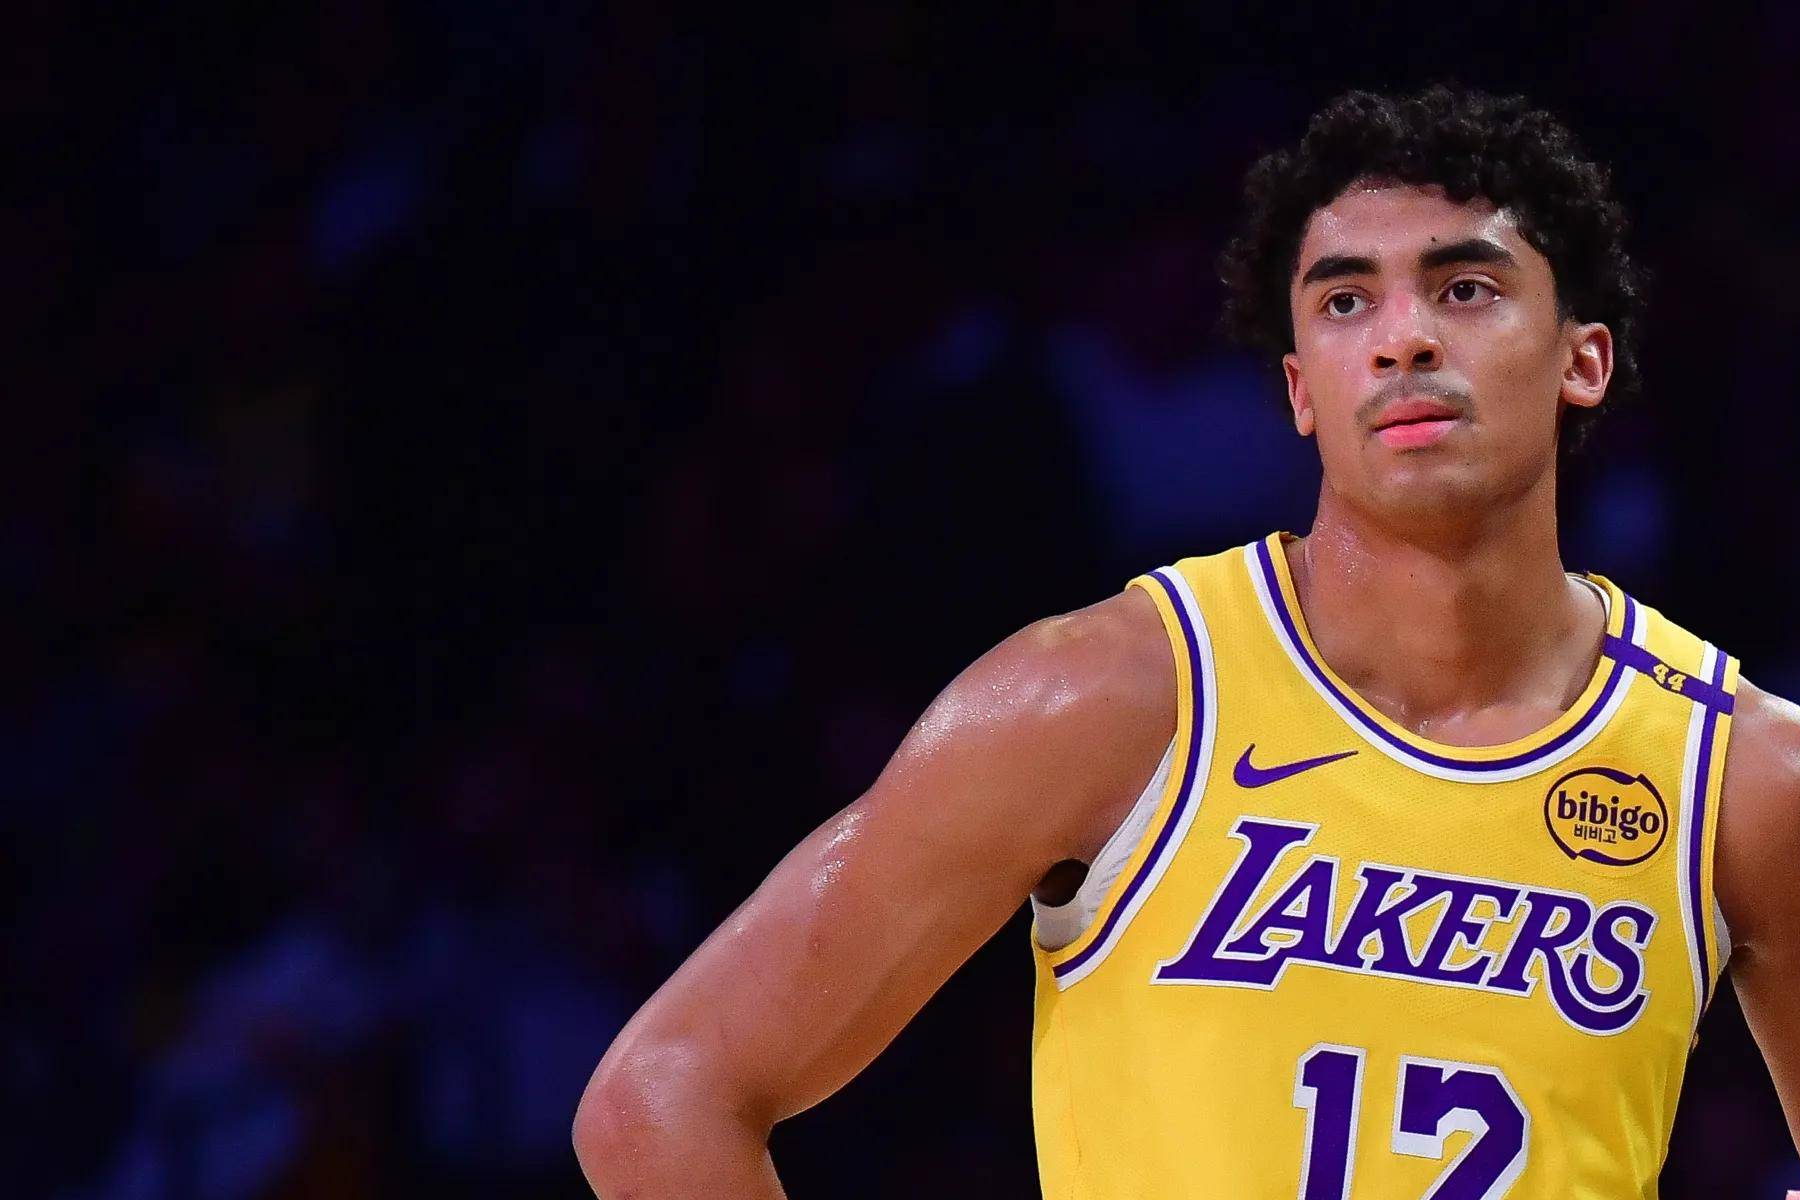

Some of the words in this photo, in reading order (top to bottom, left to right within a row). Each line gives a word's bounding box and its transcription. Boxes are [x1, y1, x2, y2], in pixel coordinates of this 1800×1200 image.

[1653, 663, 1686, 691] 44
[1557, 790, 1660, 841] bibigo
[1573, 823, 1617, 844] 비비고
[1151, 815, 1660, 1036] LAKERS
